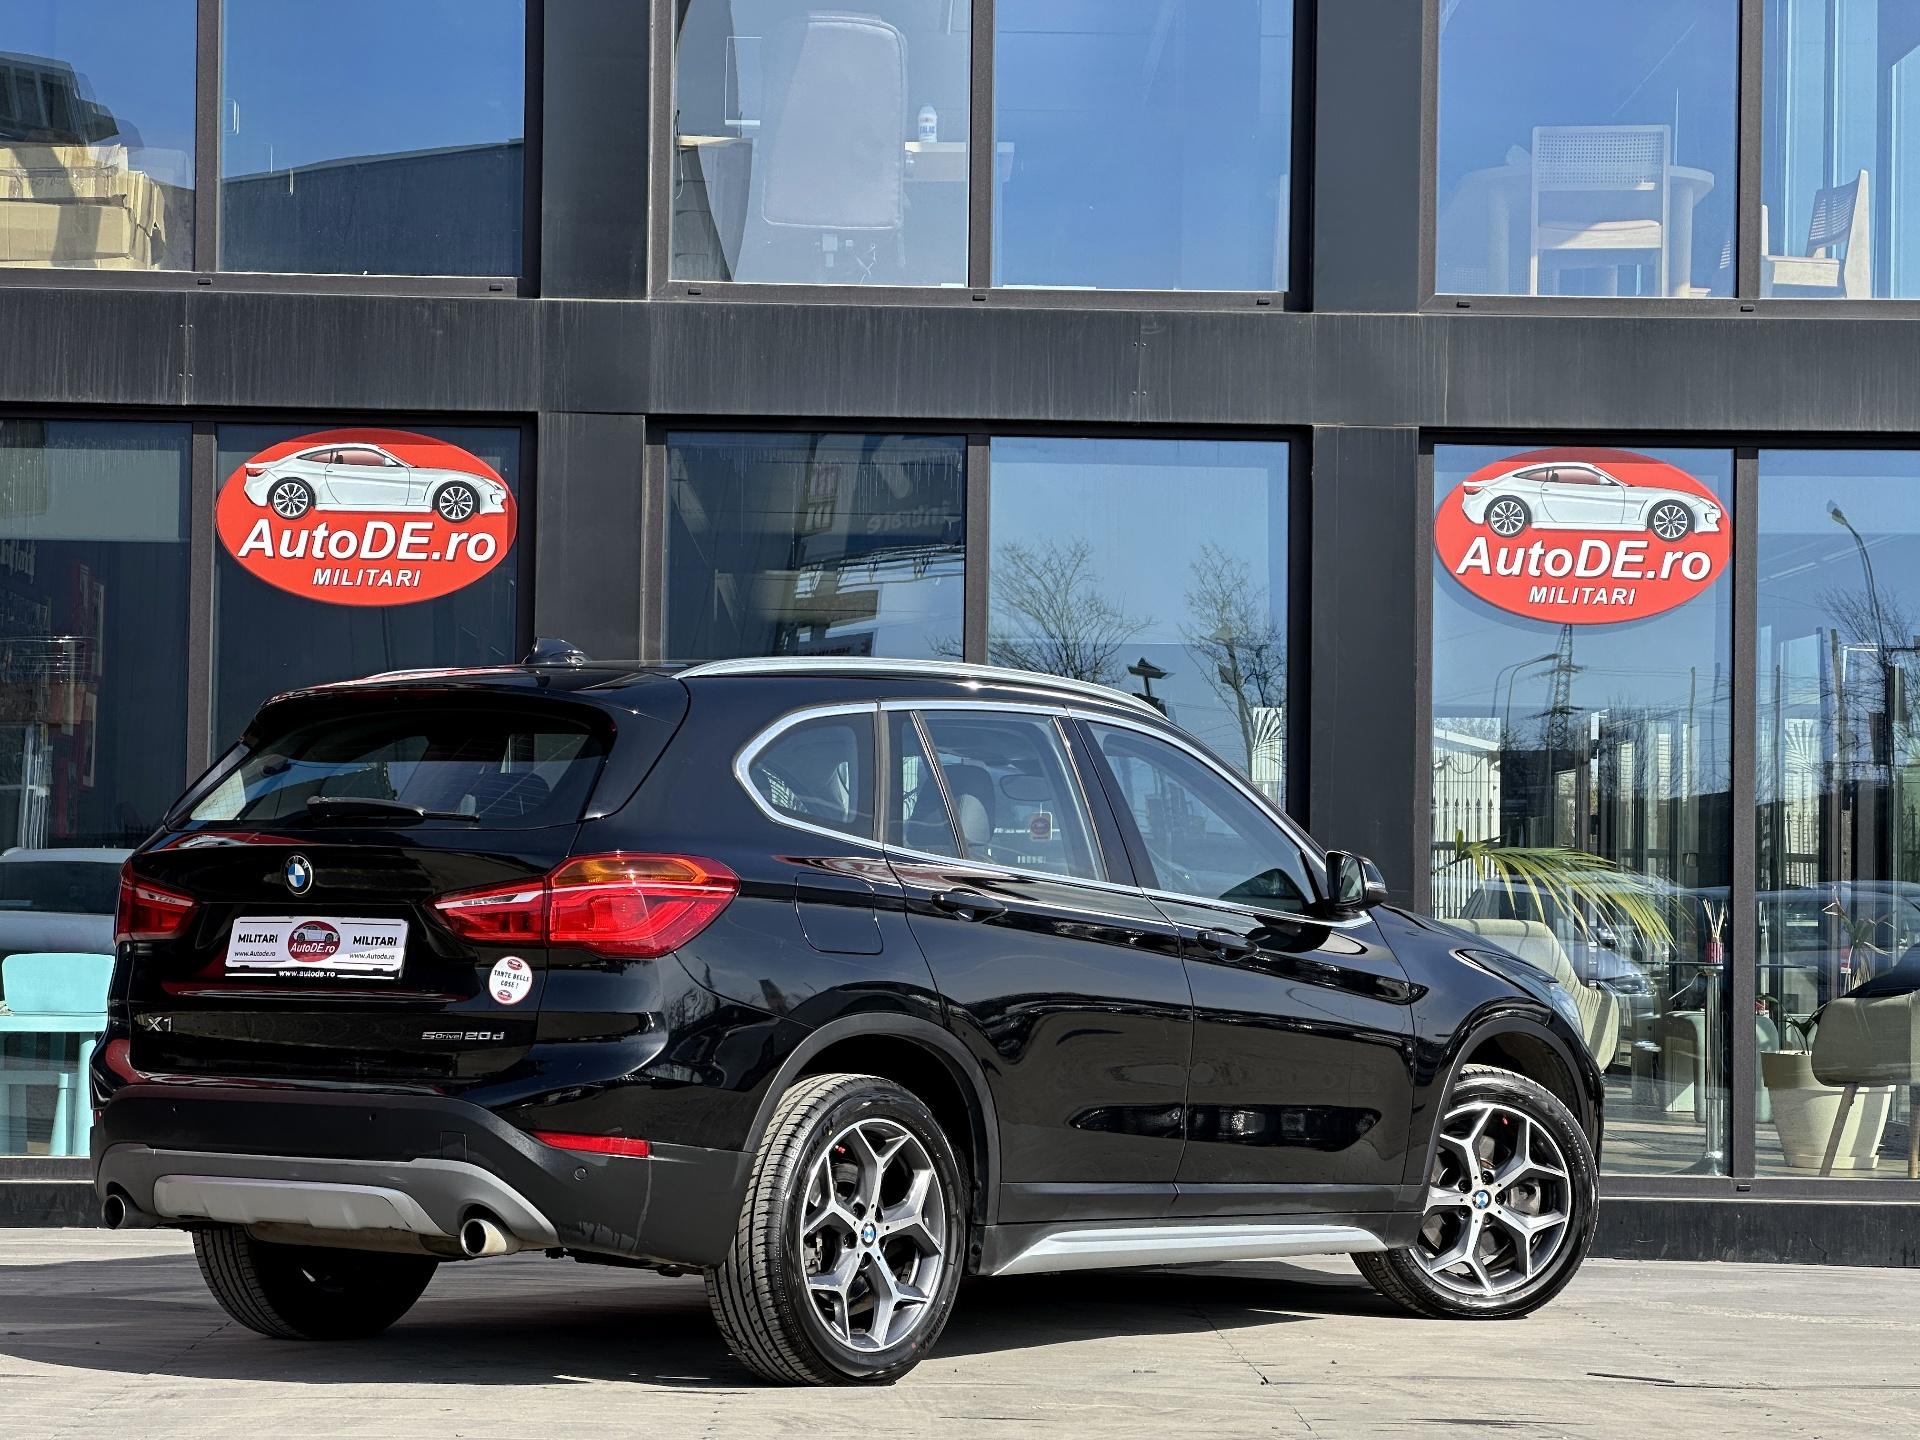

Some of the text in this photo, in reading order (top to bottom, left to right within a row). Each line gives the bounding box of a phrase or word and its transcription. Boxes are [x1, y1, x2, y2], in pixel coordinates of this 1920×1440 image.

[237, 518, 496, 562] AutoDE.ro
[1455, 536, 1712, 581] AutoDE.ro
[312, 567, 421, 587] MILITARI
[1528, 586, 1636, 606] MILITARI
[237, 933, 278, 943] MILITARI
[352, 936, 397, 946] MILITARI
[290, 943, 336, 954] AutoDE.ro
[278, 969, 336, 978] www.autode.ro
[145, 1016, 172, 1032] X1
